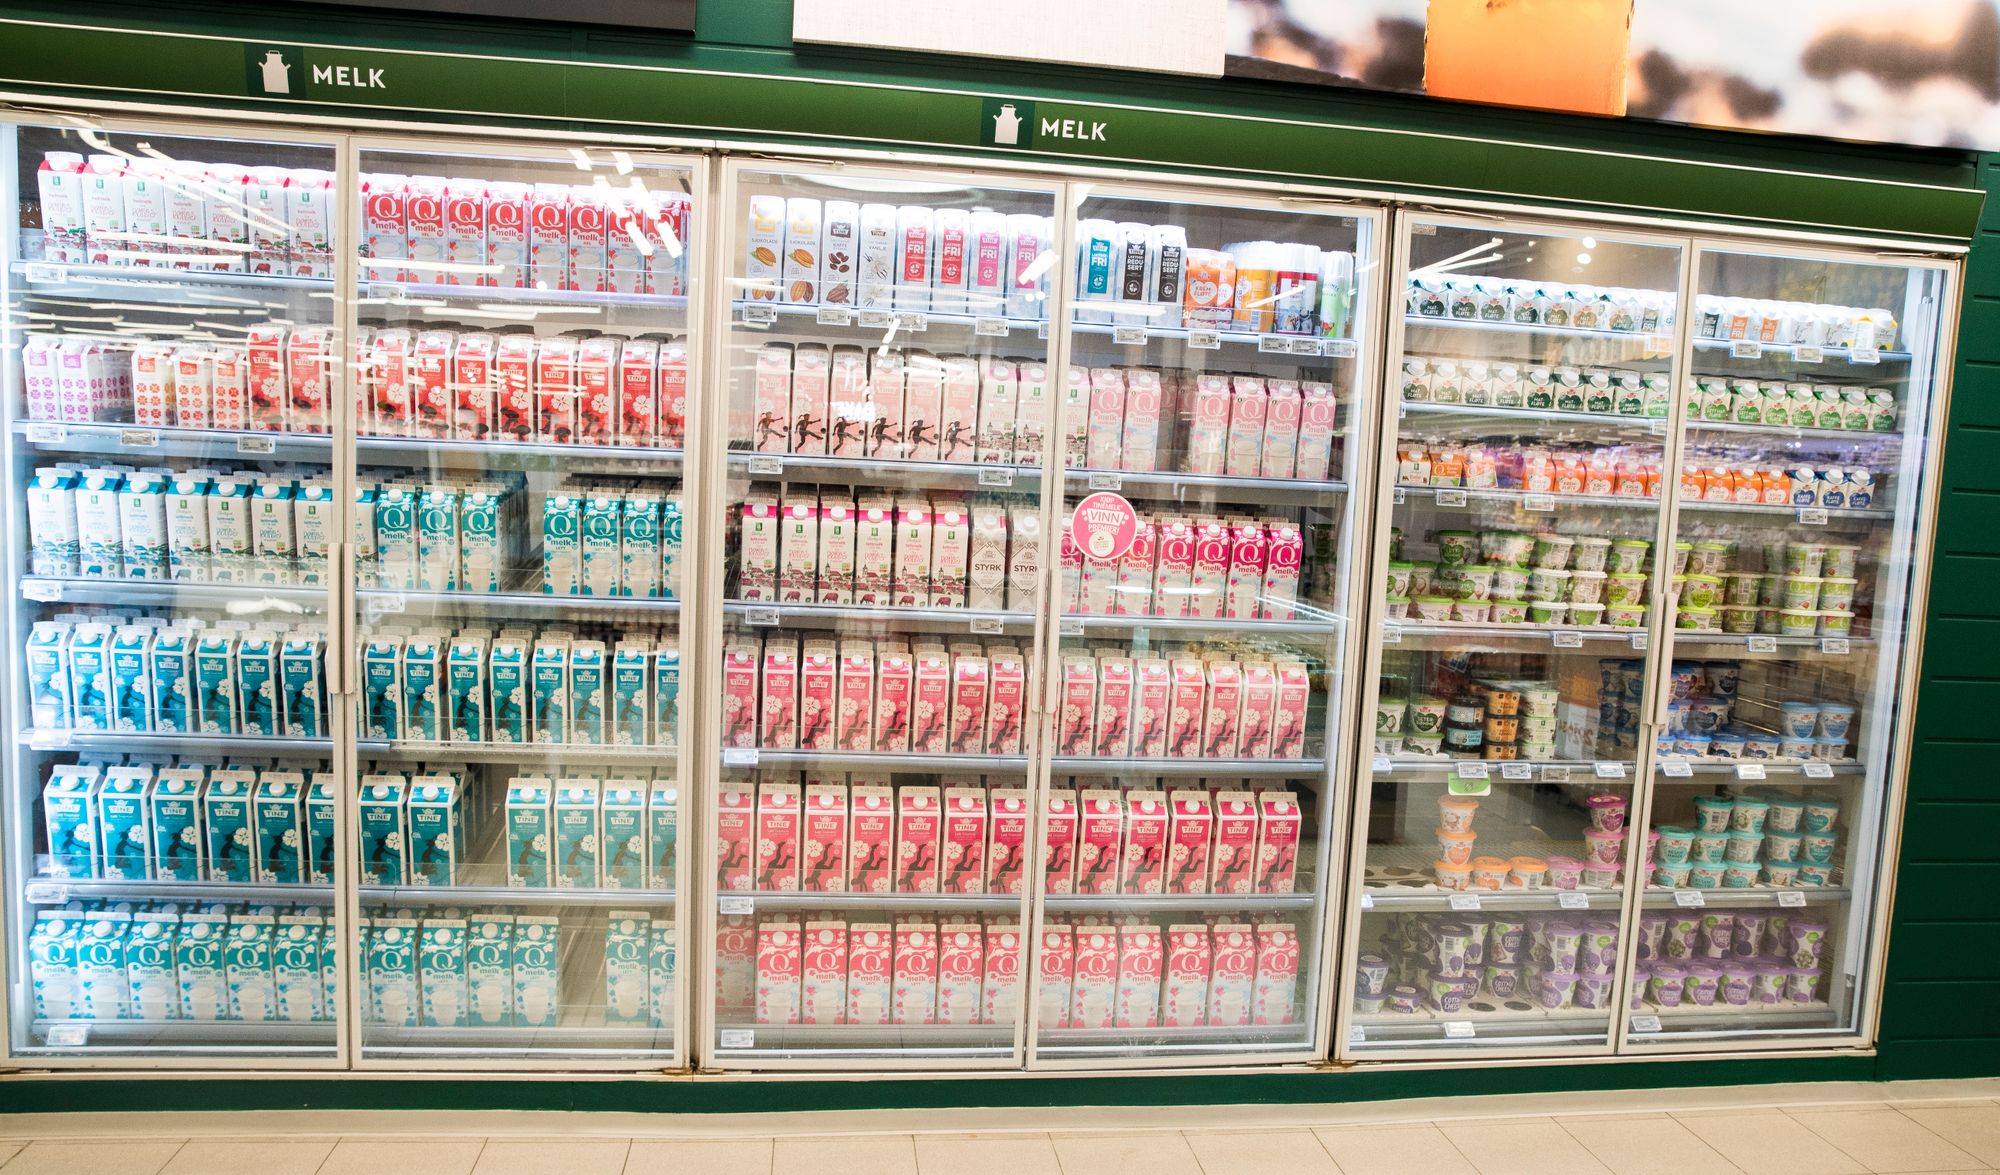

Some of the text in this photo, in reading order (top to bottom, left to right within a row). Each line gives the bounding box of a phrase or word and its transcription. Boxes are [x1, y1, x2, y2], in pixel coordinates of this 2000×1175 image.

[313, 64, 386, 88] MELK
[1041, 118, 1107, 141] MELK
[375, 197, 400, 218] Q
[414, 199, 438, 221] Q
[455, 201, 480, 223] Q
[496, 204, 520, 225] Q
[539, 206, 564, 228] Q
[577, 207, 602, 229] Q
[415, 224, 436, 232] melk
[539, 231, 559, 240] melk
[908, 245, 923, 253] FRI
[944, 247, 960, 256] FRI
[981, 250, 996, 258] FRI
[1019, 252, 1034, 260] FRI
[1092, 257, 1107, 266] FRI
[1099, 391, 1121, 410] Q
[1205, 398, 1226, 417] Q
[1241, 399, 1262, 419] Q
[1311, 404, 1331, 423] Q
[384, 508, 409, 529] Q
[426, 510, 450, 531] Q
[468, 511, 493, 532] Q
[550, 514, 575, 535] Q
[1091, 510, 1120, 523] VINN
[590, 516, 615, 537] Q
[630, 517, 654, 538] Q
[1089, 524, 1120, 535] PREMIER!
[426, 534, 447, 542] melk
[1131, 539, 1152, 558] Q
[1169, 541, 1190, 560] Q
[1204, 542, 1226, 561] Q
[1240, 544, 1261, 563] Q
[1277, 546, 1298, 565] Q
[43, 943, 66, 964] Q
[139, 946, 165, 965] Q
[285, 949, 310, 968] Q
[382, 951, 406, 970] Q
[479, 946, 503, 965] Q
[617, 943, 640, 962] Q
[1272, 953, 1292, 971] Q
[770, 954, 793, 972] Q
[907, 954, 929, 972] Q
[953, 954, 975, 973] Q
[1089, 956, 1110, 974] Q
[1182, 954, 1202, 971] Q
